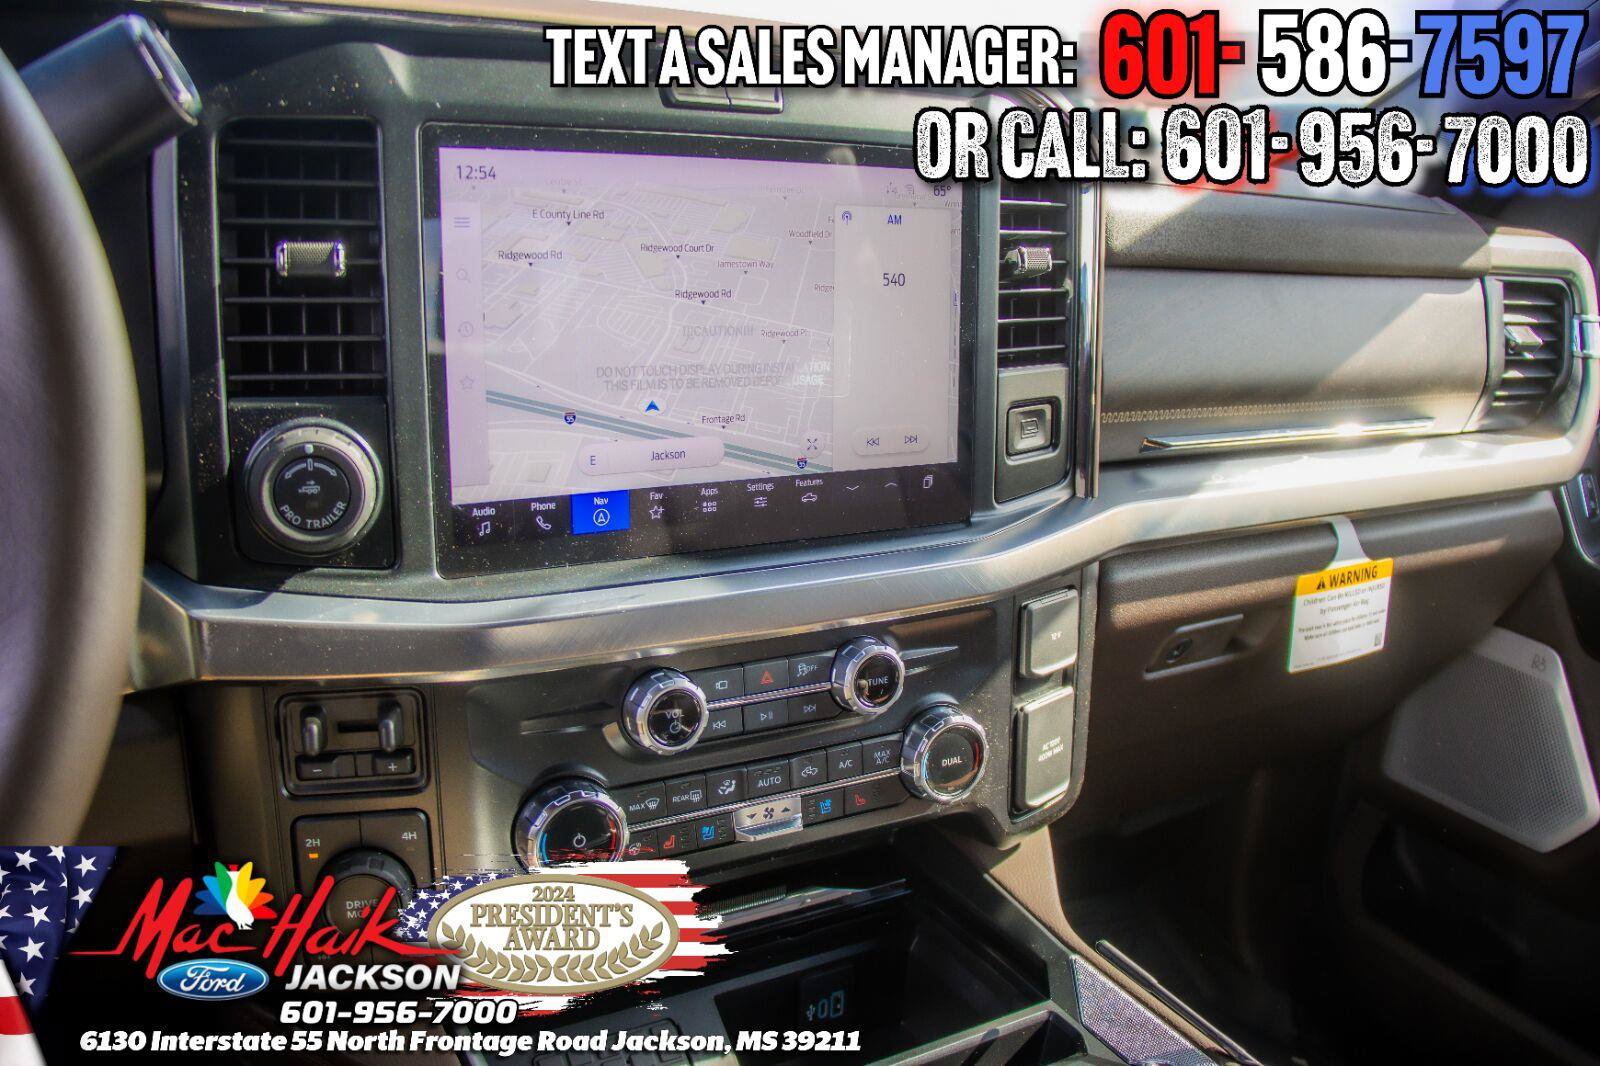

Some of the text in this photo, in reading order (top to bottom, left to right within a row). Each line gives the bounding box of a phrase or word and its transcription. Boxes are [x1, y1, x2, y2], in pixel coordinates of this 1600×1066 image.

[456, 165, 497, 180] 12:54
[933, 186, 952, 197] 65°
[532, 209, 605, 221] E County Line Rd
[887, 215, 902, 225] AM
[789, 230, 821, 239] Woodfield
[640, 243, 714, 253] Ridgewood Court Dr
[498, 250, 563, 261] Ridgewood Rd
[718, 260, 774, 270] Jamestown Way
[883, 273, 905, 287] 540
[675, 289, 732, 300] Ridgewood Rd
[761, 329, 799, 338] Ridgewood
[597, 367, 613, 378] DO
[615, 367, 637, 377] NOT
[640, 366, 677, 377] TOUCH
[678, 364, 721, 376] DISPLAY
[724, 363, 760, 375] DURING
[604, 380, 629, 391] THIS
[631, 379, 655, 390] FILM
[670, 379, 686, 389] TO
[687, 378, 702, 388] BE
[703, 376, 751, 388] REMOVED
[701, 414, 746, 425] Frontage Rd
[650, 449, 686, 461] Jackson
[590, 456, 596, 466] E
[747, 481, 775, 493] Settings
[795, 478, 823, 487] Features
[650, 492, 663, 500] Fav
[701, 486, 718, 497] Apps
[531, 501, 556, 511] Phone
[594, 497, 609, 505] Nav
[280, 501, 347, 529] PRO TRAILER
[472, 507, 496, 517] Audio
[1328, 565, 1379, 588] WARNING
[806, 663, 819, 673] OFF
[867, 675, 889, 685] TUNE
[666, 710, 684, 720] VOL
[874, 749, 891, 759] MAX
[839, 759, 853, 769] A/C
[941, 756, 963, 767] DUAL
[758, 775, 782, 787] AUTO
[672, 794, 690, 803] REAR
[629, 803, 646, 812] MAX
[402, 832, 417, 841] 4H
[305, 839, 320, 848] 2H
